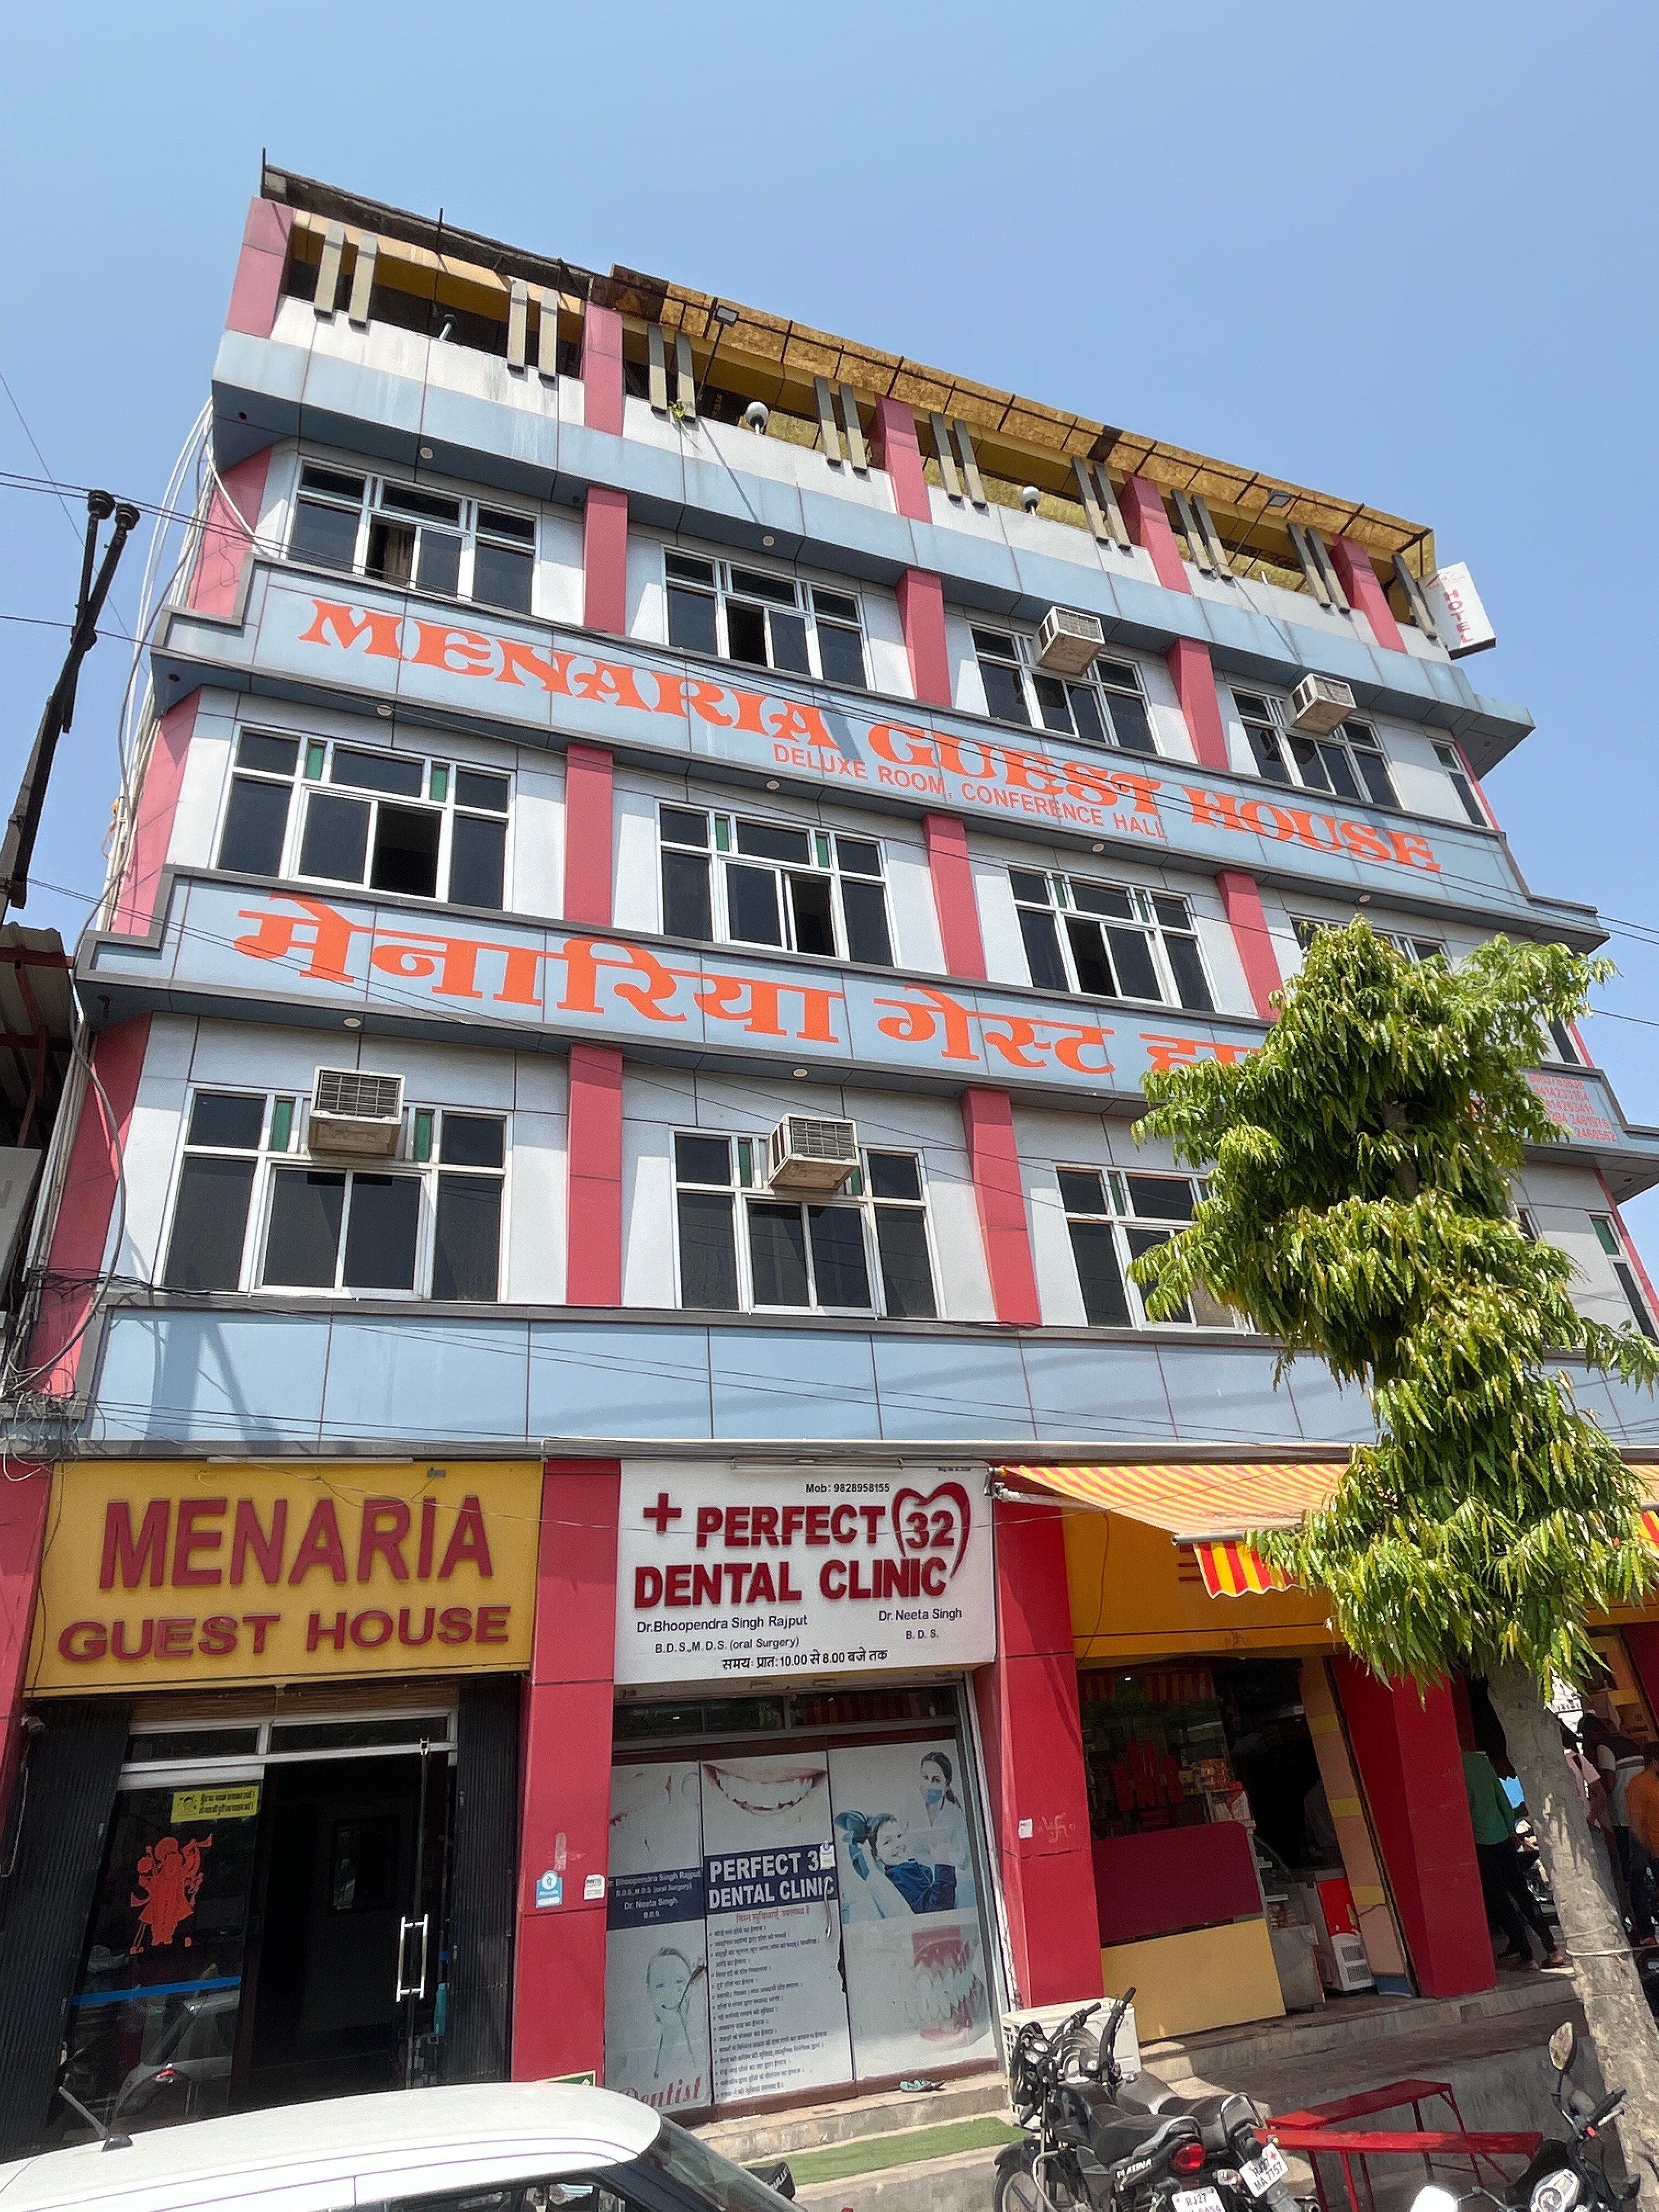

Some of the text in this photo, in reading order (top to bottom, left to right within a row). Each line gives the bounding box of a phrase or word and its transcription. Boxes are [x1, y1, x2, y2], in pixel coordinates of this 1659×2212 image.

[1443, 589, 1475, 644] HOTEL
[298, 599, 1441, 872] MENARIA GUEST HOUSE
[774, 743, 869, 780] DELUXE
[961, 783, 1105, 827] CONFERENCE
[1113, 812, 1168, 839] HALL
[234, 891, 845, 1044] मेनारिया
[874, 986, 1114, 1075] गेस्ट
[805, 1482, 890, 1493] Mob: 9828958155
[99, 1494, 493, 1590] MENARIA
[697, 1504, 955, 1549] PERFECT 32
[634, 1557, 947, 1609] DENTAL CLINIC
[58, 1605, 511, 1663] GUEST HOUSE
[731, 1616, 764, 1630] Singh
[769, 1614, 808, 1629] Rajput
[878, 1607, 963, 1622] Dr. Neeta Singh
[730, 1638, 753, 1651] (oral
[756, 1636, 799, 1649] Surgery)
[810, 1649, 821, 1664] से
[822, 1651, 845, 1663] 8.00
[847, 1646, 867, 1662] बजे
[869, 1649, 888, 1661] तक
[709, 1852, 802, 1883] PERFECT
[709, 1875, 834, 1909] DENTAL CLINIC
[1185, 2192, 1207, 2206] RJ27
